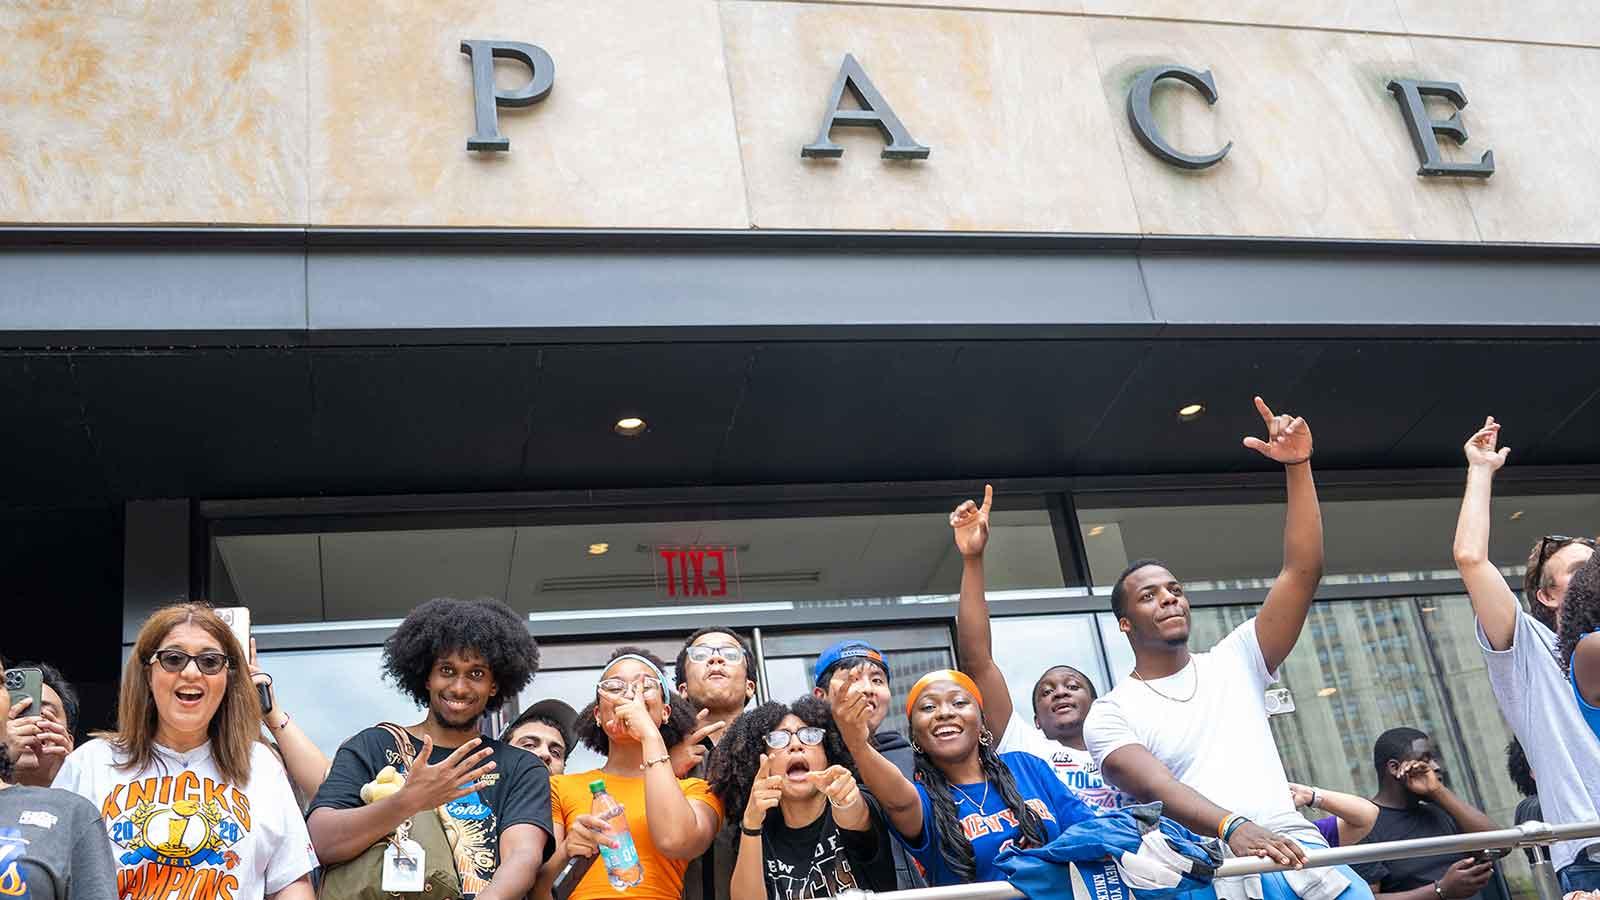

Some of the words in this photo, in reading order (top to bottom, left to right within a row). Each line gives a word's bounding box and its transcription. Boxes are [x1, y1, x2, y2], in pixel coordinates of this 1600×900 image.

[460, 40, 1496, 179] PACE
[102, 770, 251, 833] KNICKS
[113, 821, 133, 842] 20
[157, 855, 192, 867] NBA
[767, 859, 795, 874] EW
[117, 862, 239, 900] HAMPIONS
[1104, 864, 1120, 885] NEW
